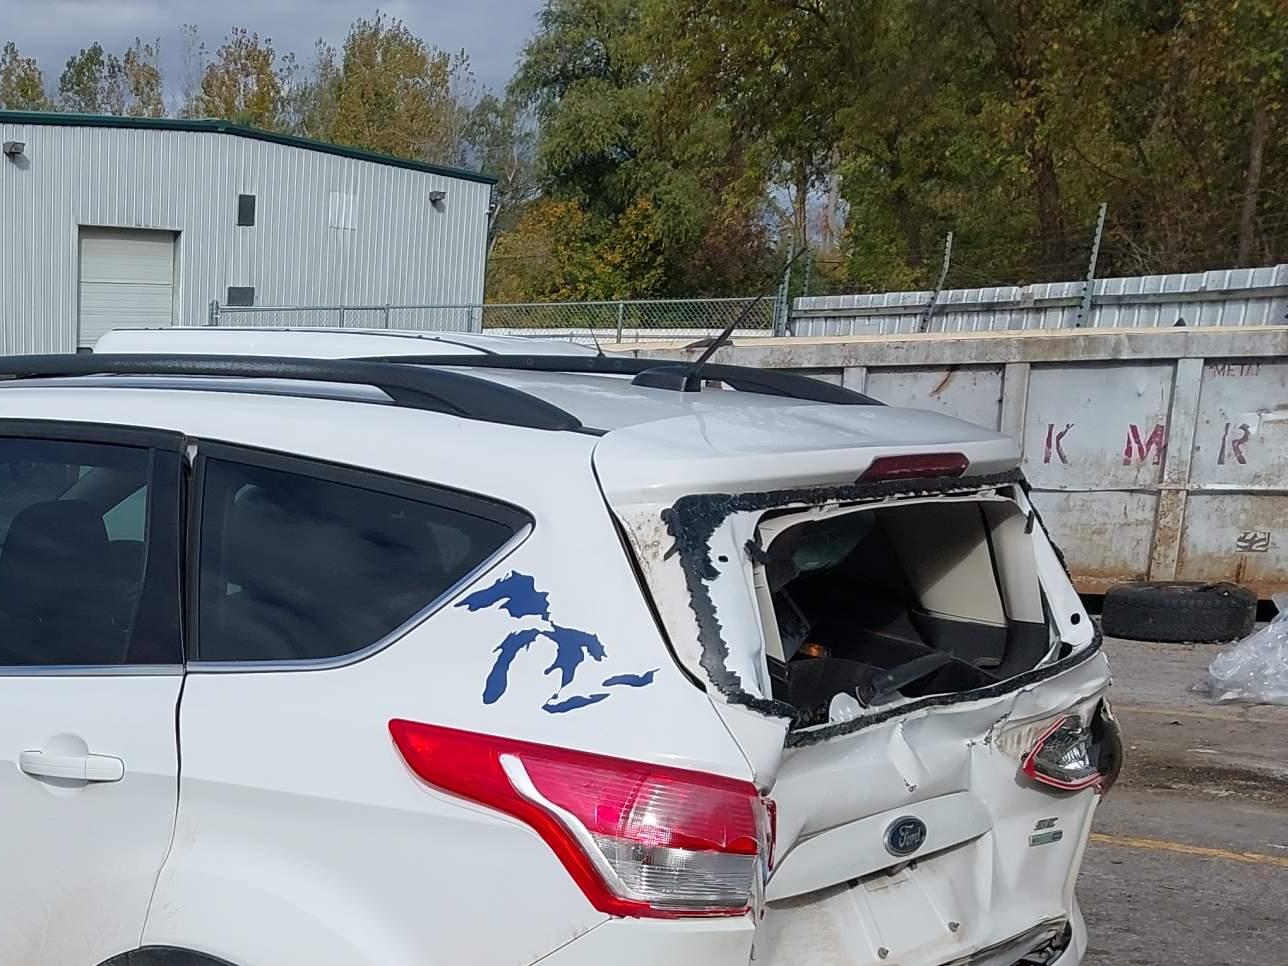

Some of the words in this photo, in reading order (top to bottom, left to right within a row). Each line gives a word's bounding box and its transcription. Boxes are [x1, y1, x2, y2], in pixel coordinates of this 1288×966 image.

[1043, 423, 1074, 464] K
[1123, 424, 1165, 465] M
[1217, 422, 1250, 465] R
[899, 824, 921, 848] Ford
